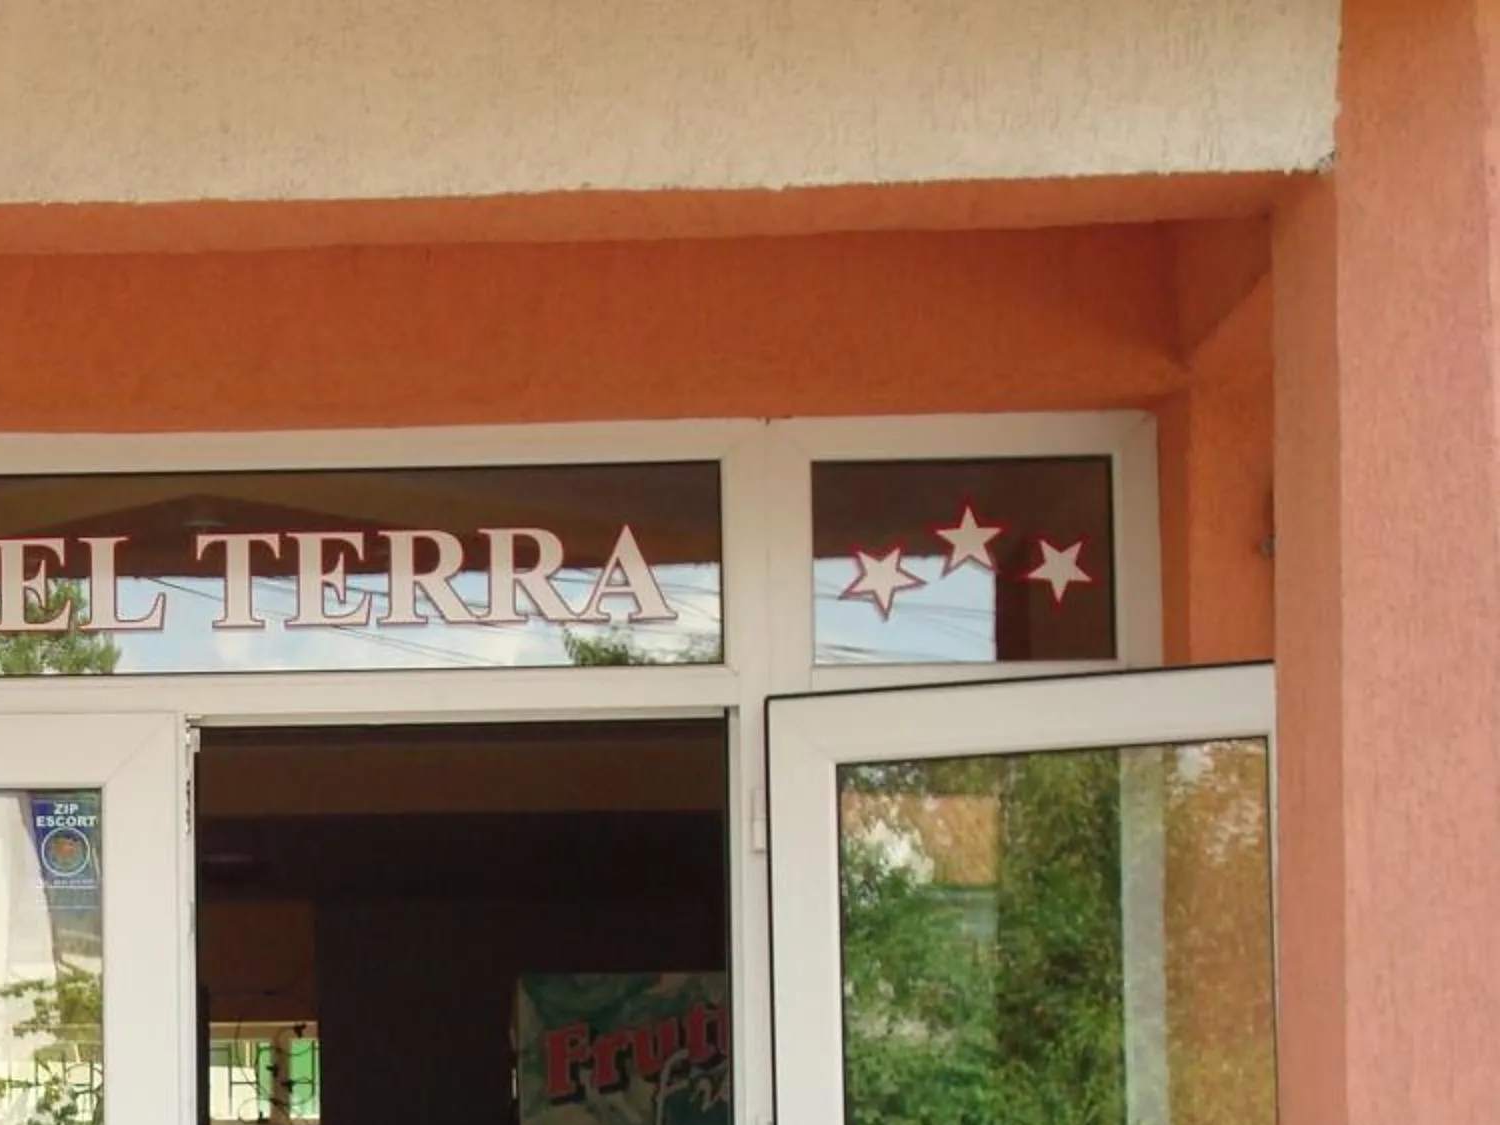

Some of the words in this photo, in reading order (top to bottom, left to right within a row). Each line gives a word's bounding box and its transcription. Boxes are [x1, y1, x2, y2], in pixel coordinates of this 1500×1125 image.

[195, 523, 680, 630] TERRA
[53, 803, 80, 815] ZIP
[35, 815, 97, 827] ESCORT
